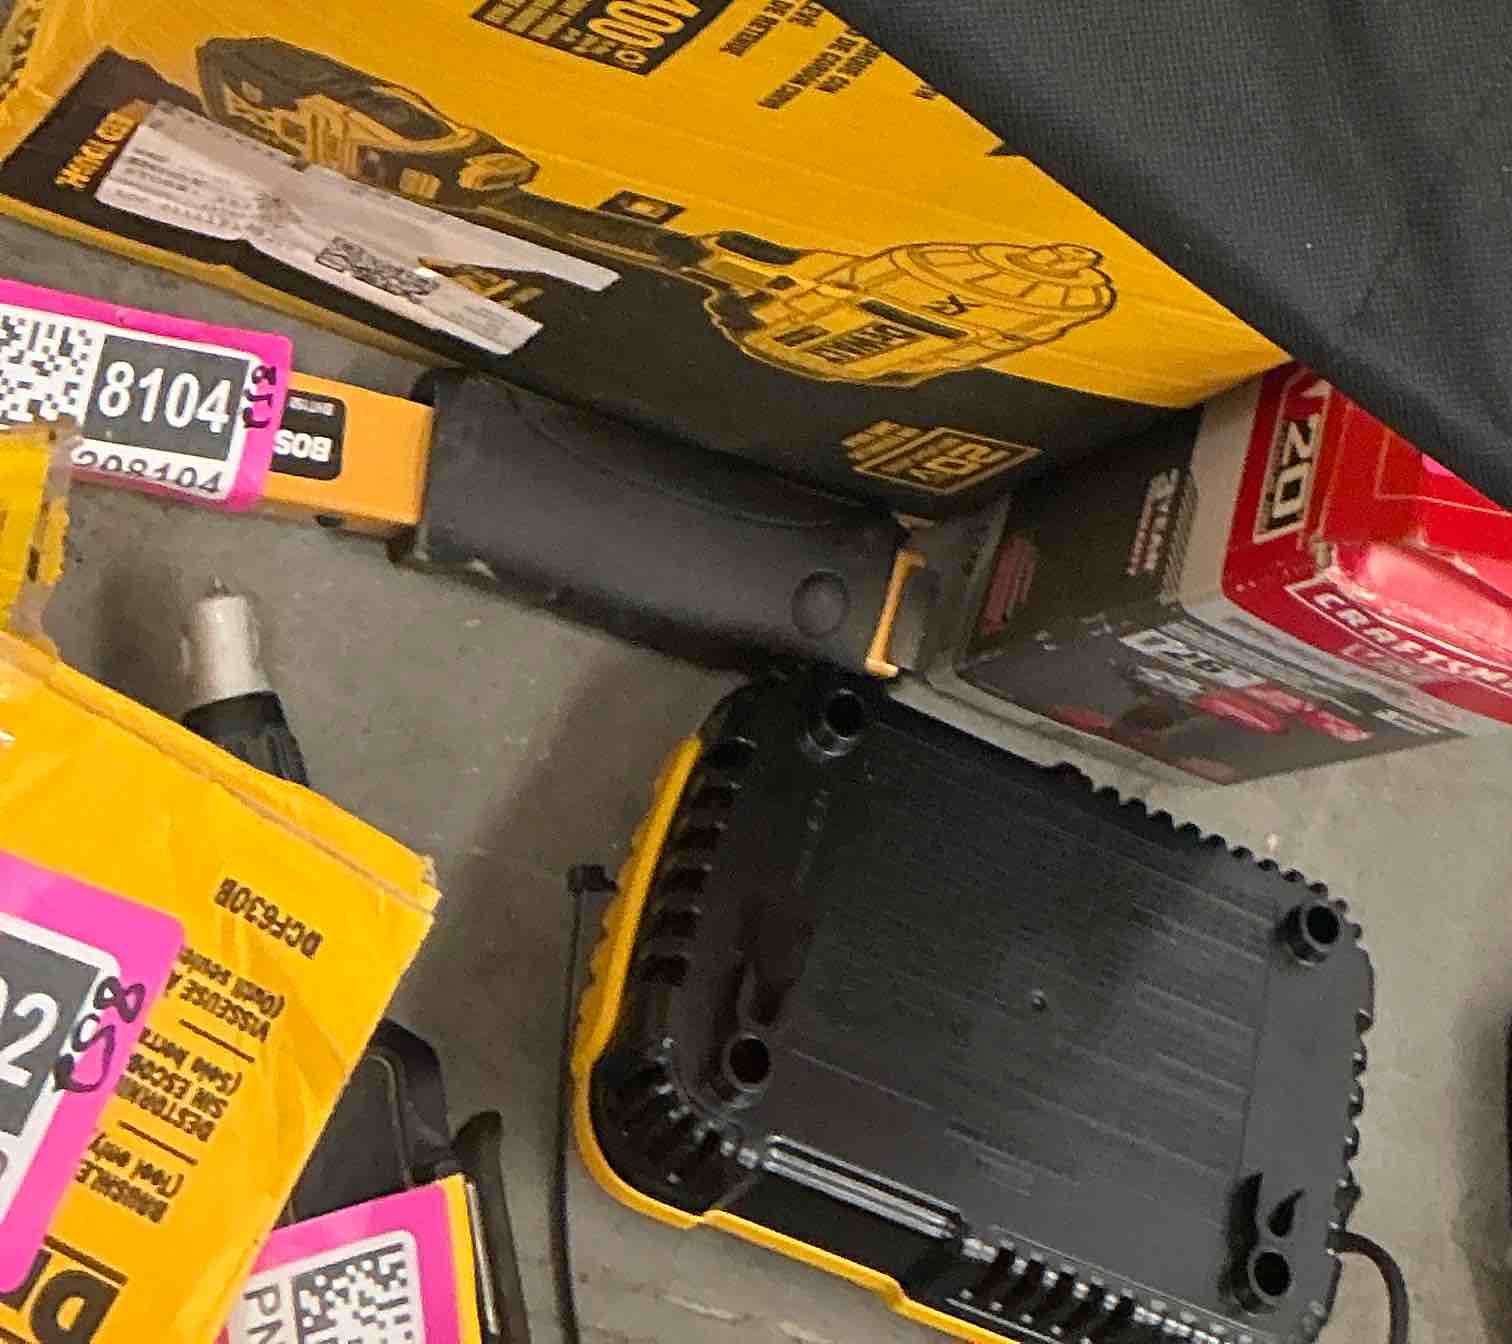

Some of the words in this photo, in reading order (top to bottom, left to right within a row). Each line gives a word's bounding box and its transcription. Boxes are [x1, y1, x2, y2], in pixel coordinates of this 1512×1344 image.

[96, 359, 233, 436] 8104
[213, 877, 324, 960] DCF630B
[178, 978, 272, 1043] VISSEUSE
